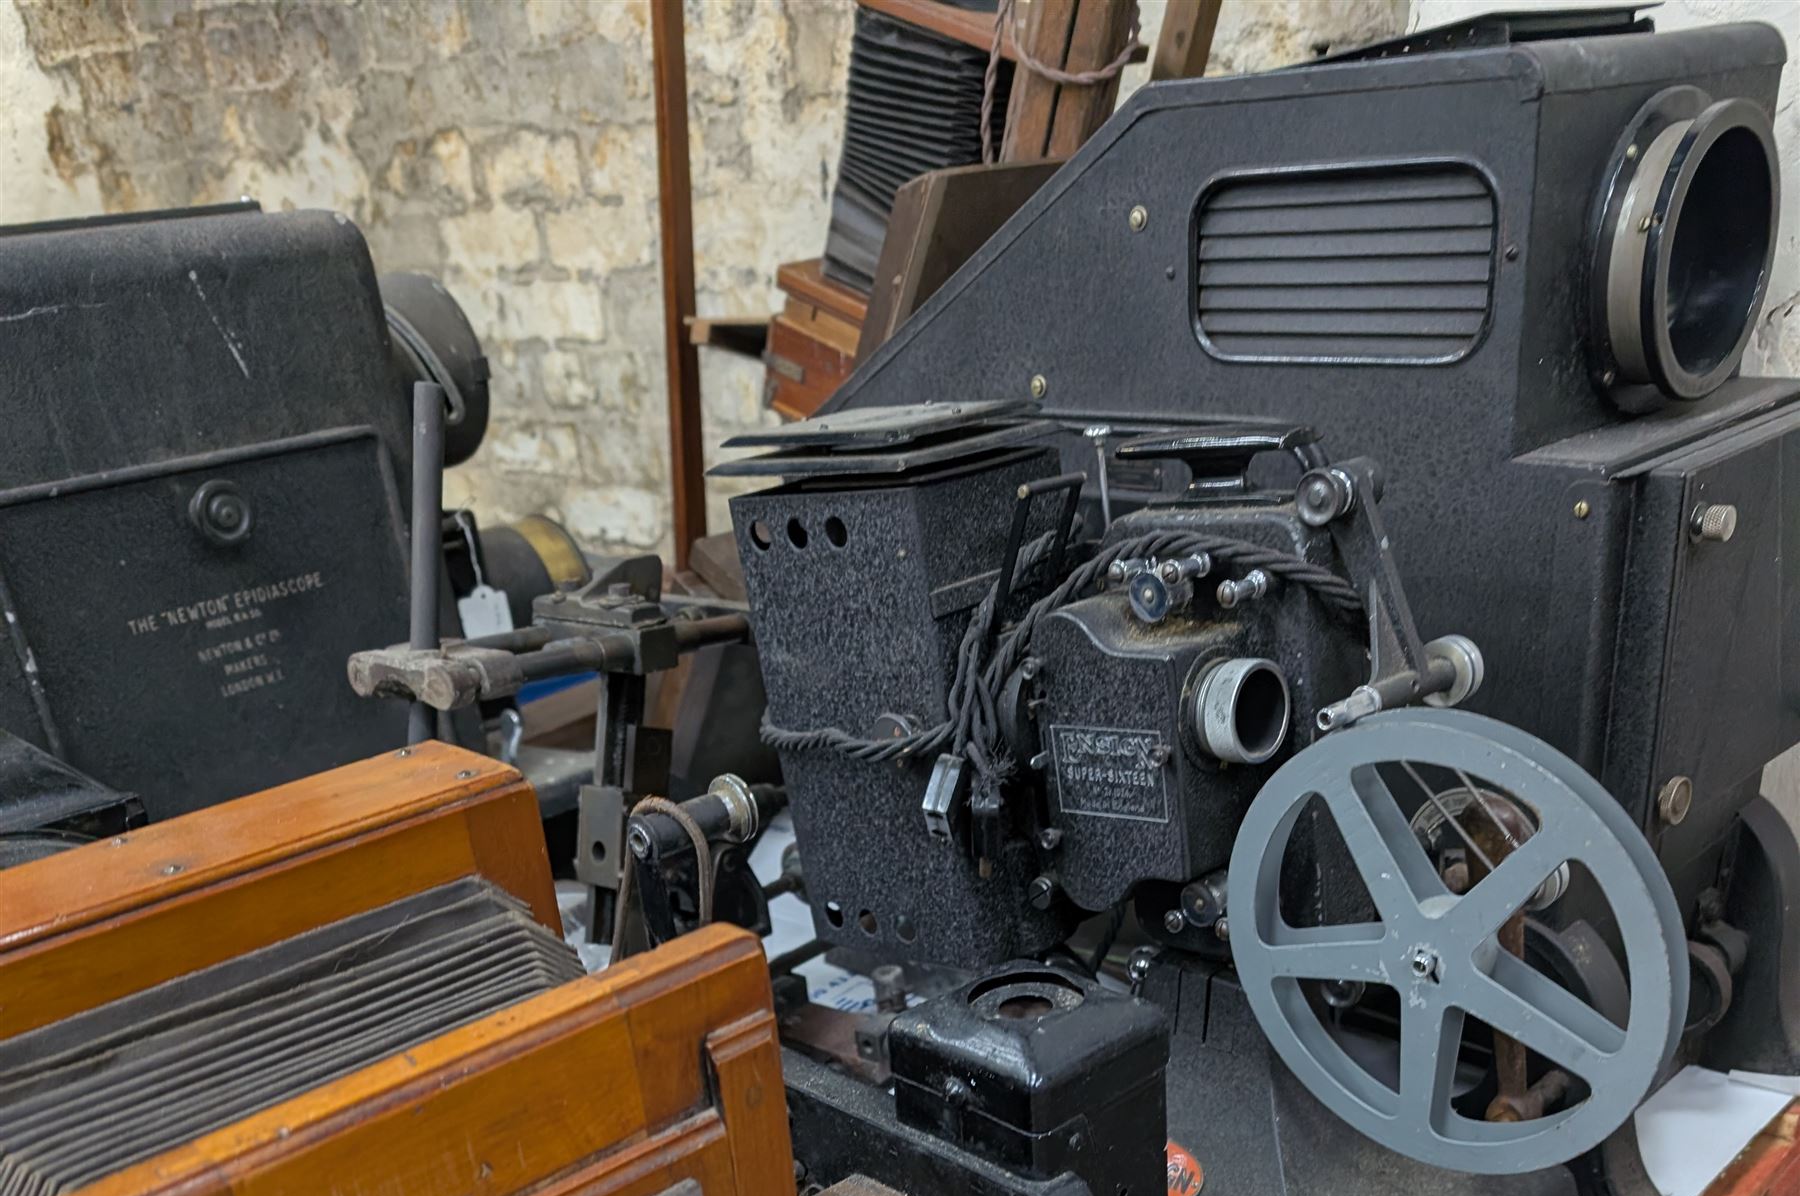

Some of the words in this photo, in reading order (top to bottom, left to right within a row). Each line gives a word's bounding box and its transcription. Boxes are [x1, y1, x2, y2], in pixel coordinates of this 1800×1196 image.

[128, 614, 159, 636] THE
[234, 572, 323, 607] EPIDIASCOPE
[197, 640, 243, 662] NEWTON
[243, 636, 254, 649] &
[223, 653, 268, 676] MAKERS
[220, 673, 265, 698] LONDON
[1060, 731, 1155, 770] ENSIGN
[1066, 765, 1155, 787] SUPER-SIXTEEN
